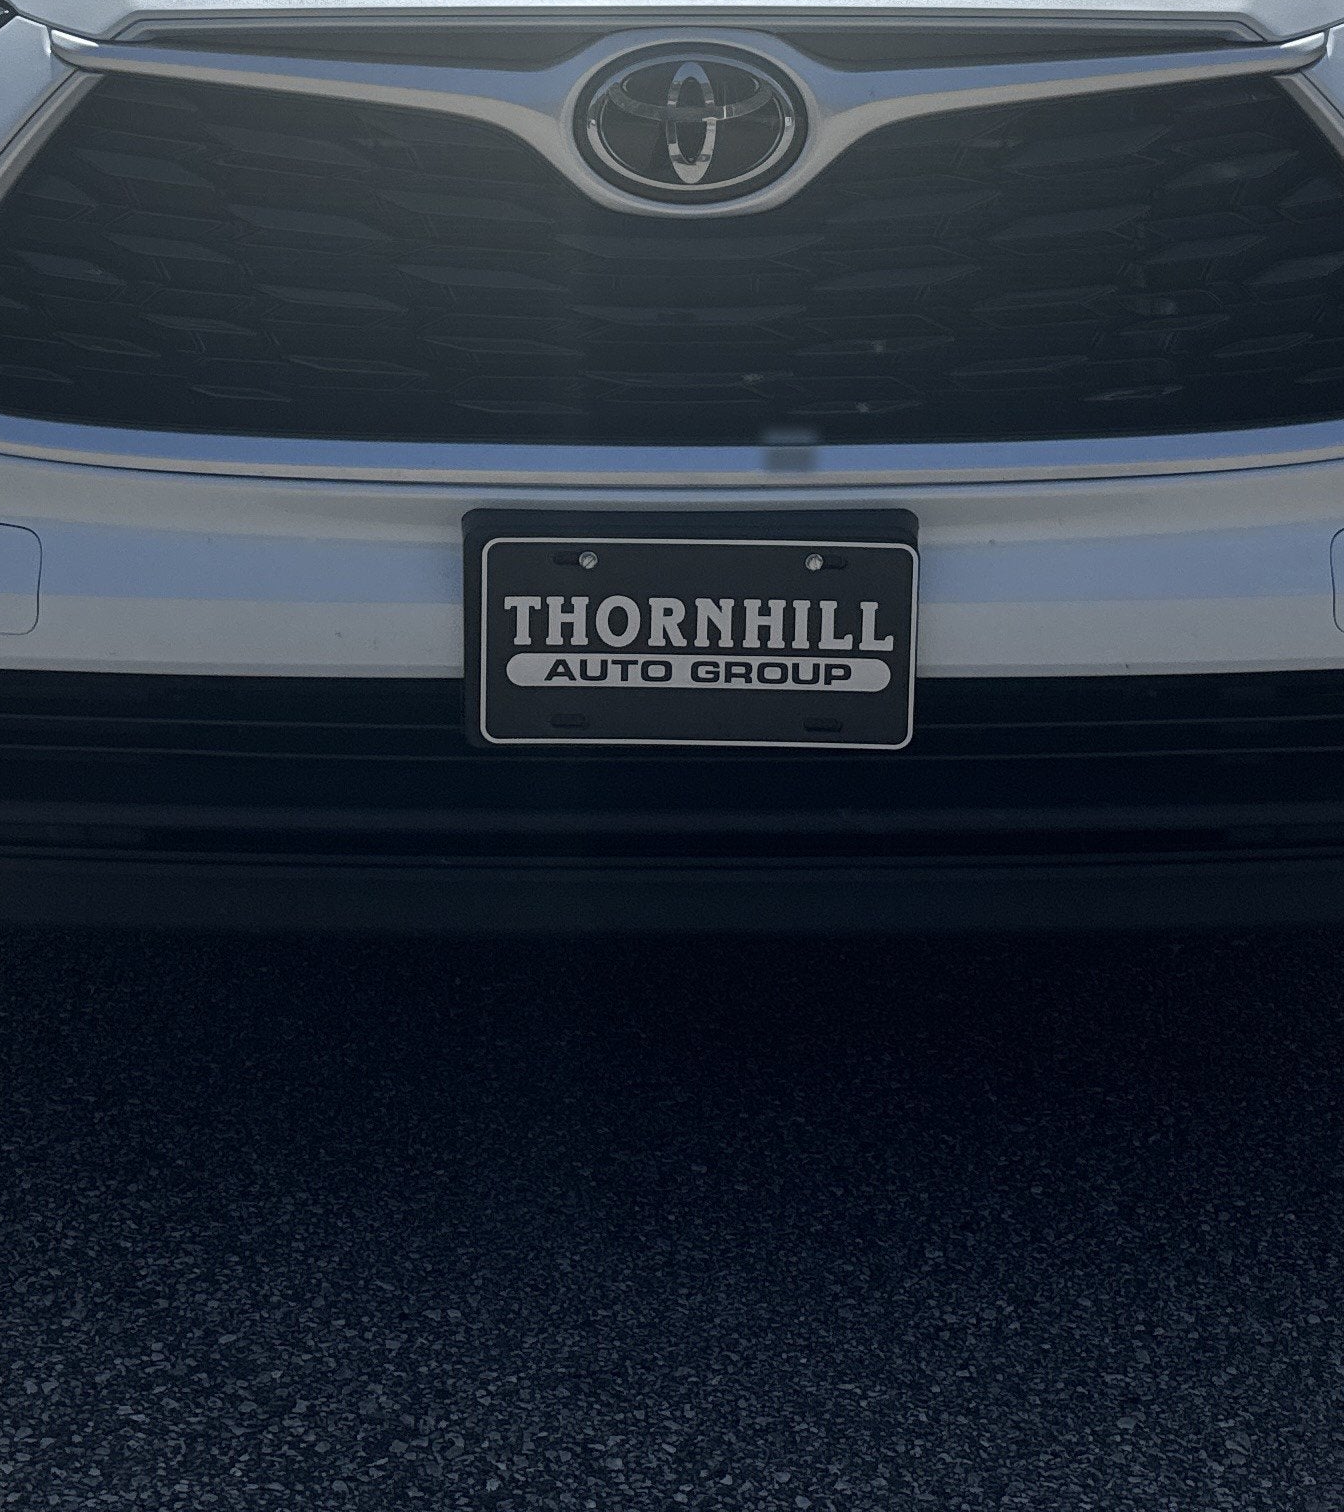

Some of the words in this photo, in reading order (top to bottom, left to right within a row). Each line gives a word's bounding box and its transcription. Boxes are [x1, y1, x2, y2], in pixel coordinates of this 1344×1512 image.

[504, 595, 894, 652] THORNHILL
[544, 658, 673, 683] AUTO
[690, 661, 853, 686] GROUP
